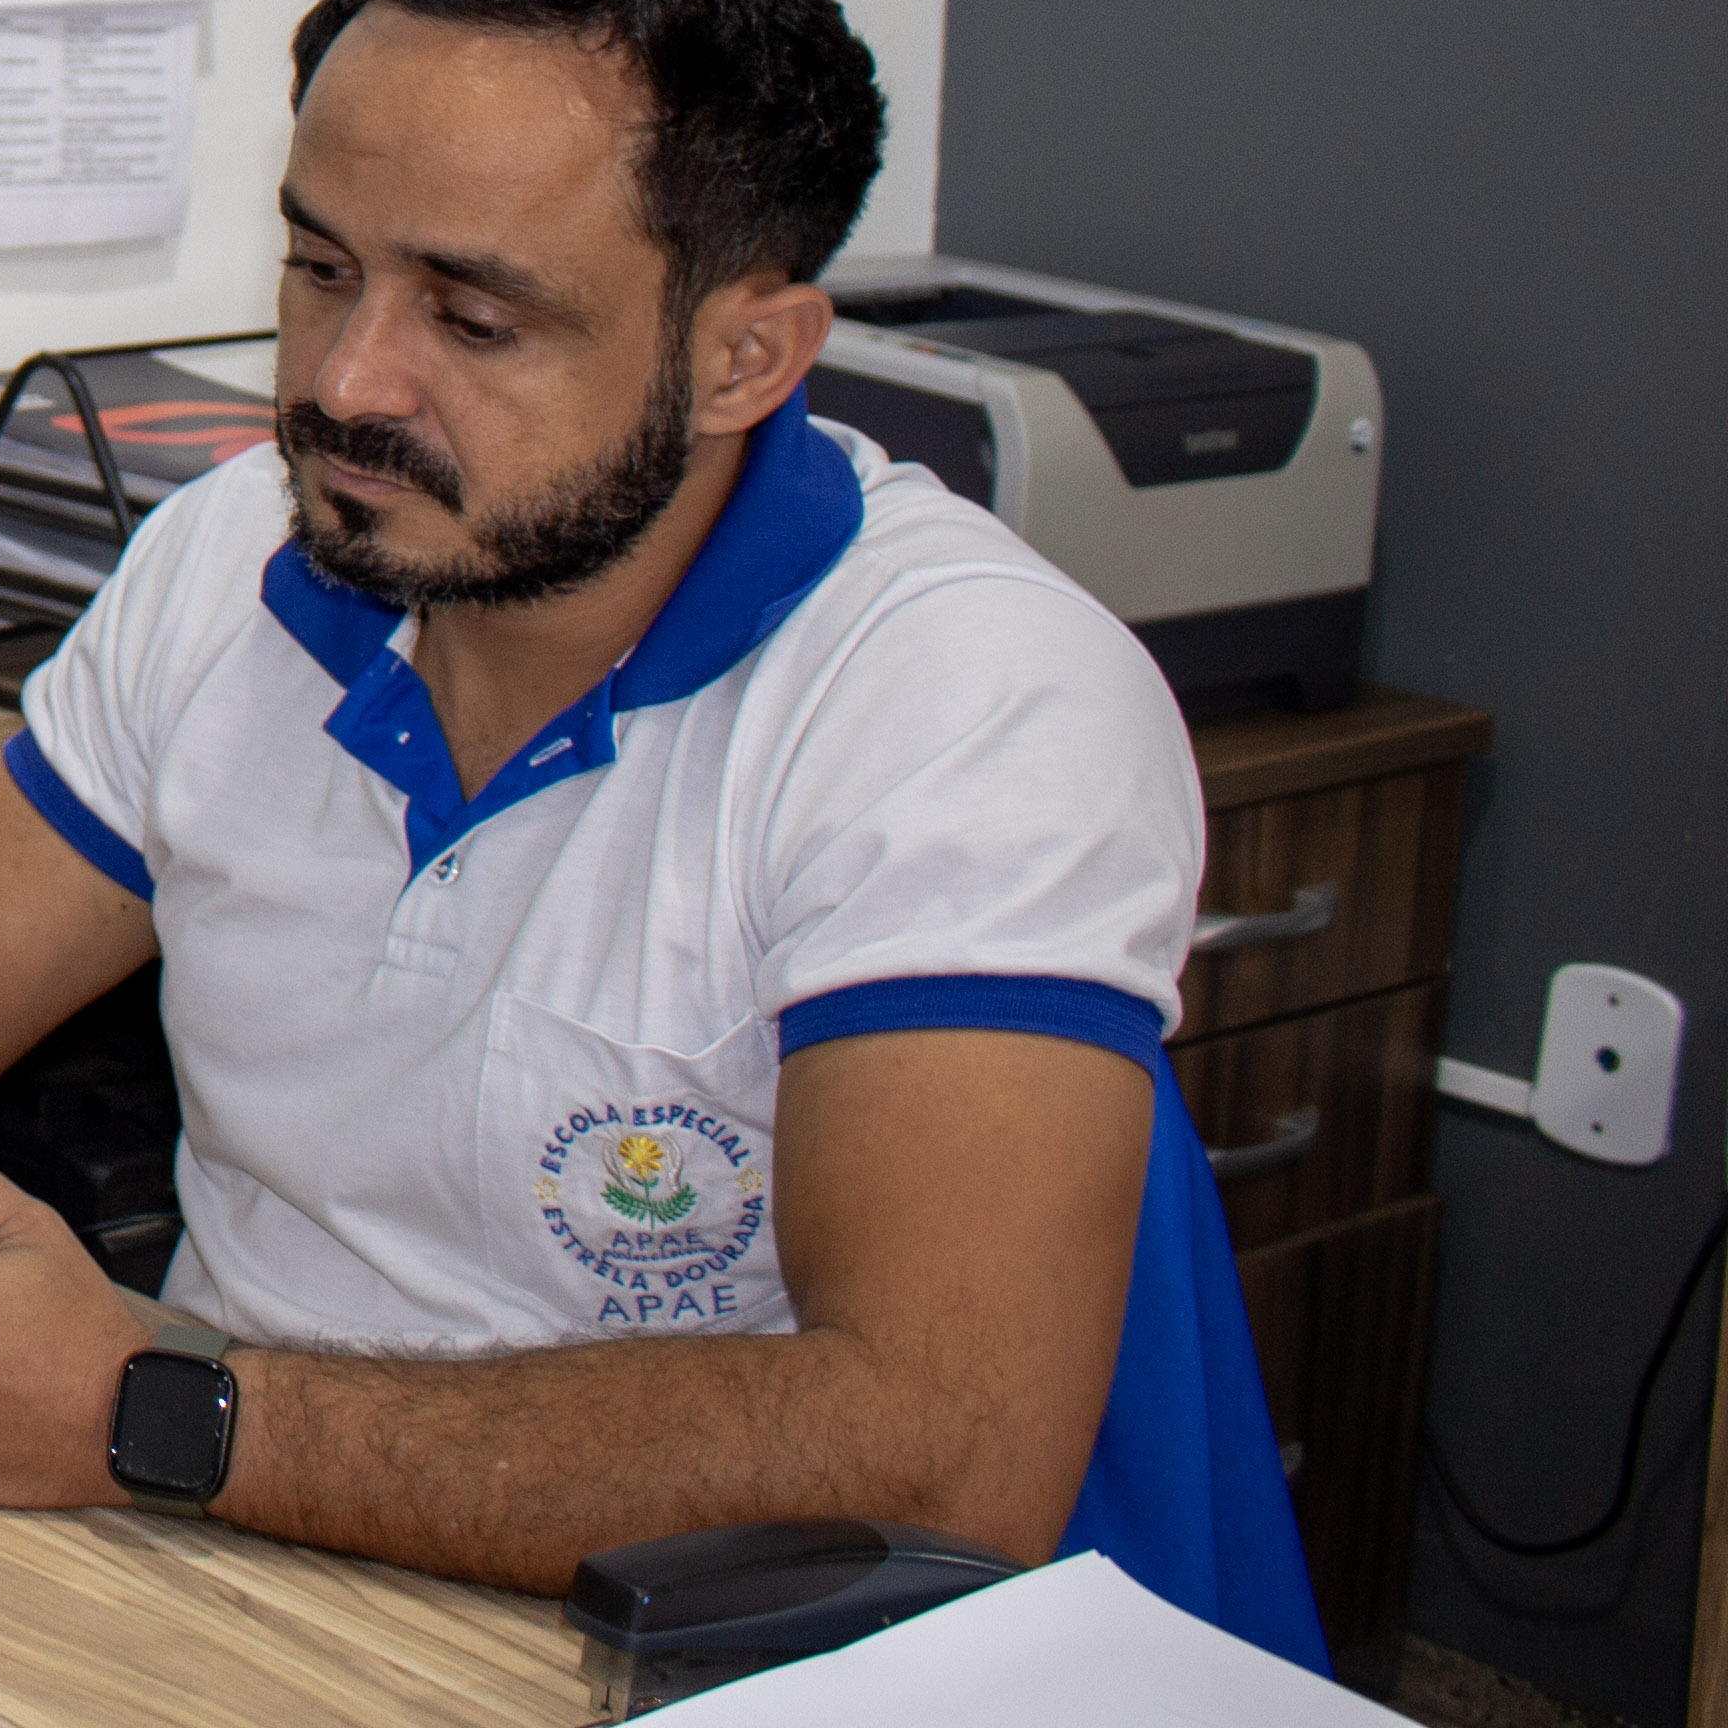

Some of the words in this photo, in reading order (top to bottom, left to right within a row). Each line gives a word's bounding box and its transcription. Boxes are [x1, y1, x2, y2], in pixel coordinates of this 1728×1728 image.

[540, 1103, 622, 1174] ESCOLA
[632, 1104, 750, 1168] ESPECIAL
[543, 1206, 649, 1291] ESTRELA
[664, 1194, 765, 1289] DOURADA
[611, 1228, 704, 1252] APAE
[598, 1283, 739, 1323] APAE
